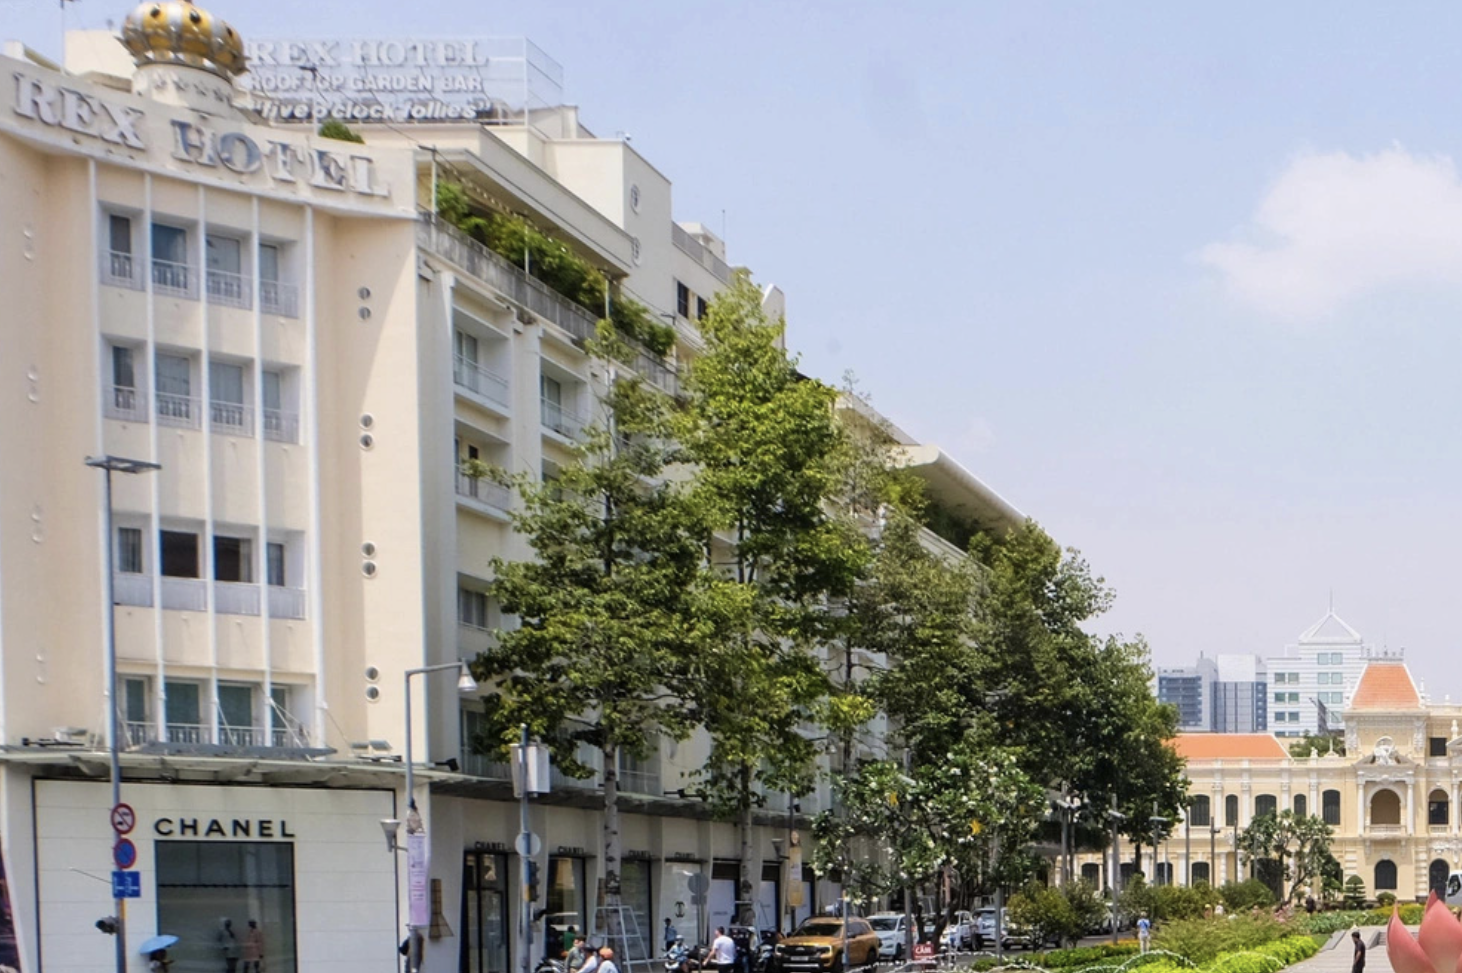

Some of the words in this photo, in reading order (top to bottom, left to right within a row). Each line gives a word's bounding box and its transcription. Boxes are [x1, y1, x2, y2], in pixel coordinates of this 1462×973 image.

[249, 41, 341, 67] REX
[351, 41, 489, 67] HOTEL
[250, 74, 345, 93] ROOFTOP
[351, 74, 434, 93] GARDEN
[442, 74, 484, 92] BAR
[13, 72, 146, 151] REX
[170, 118, 389, 198] HOTEL
[154, 817, 295, 838] CHANEL
